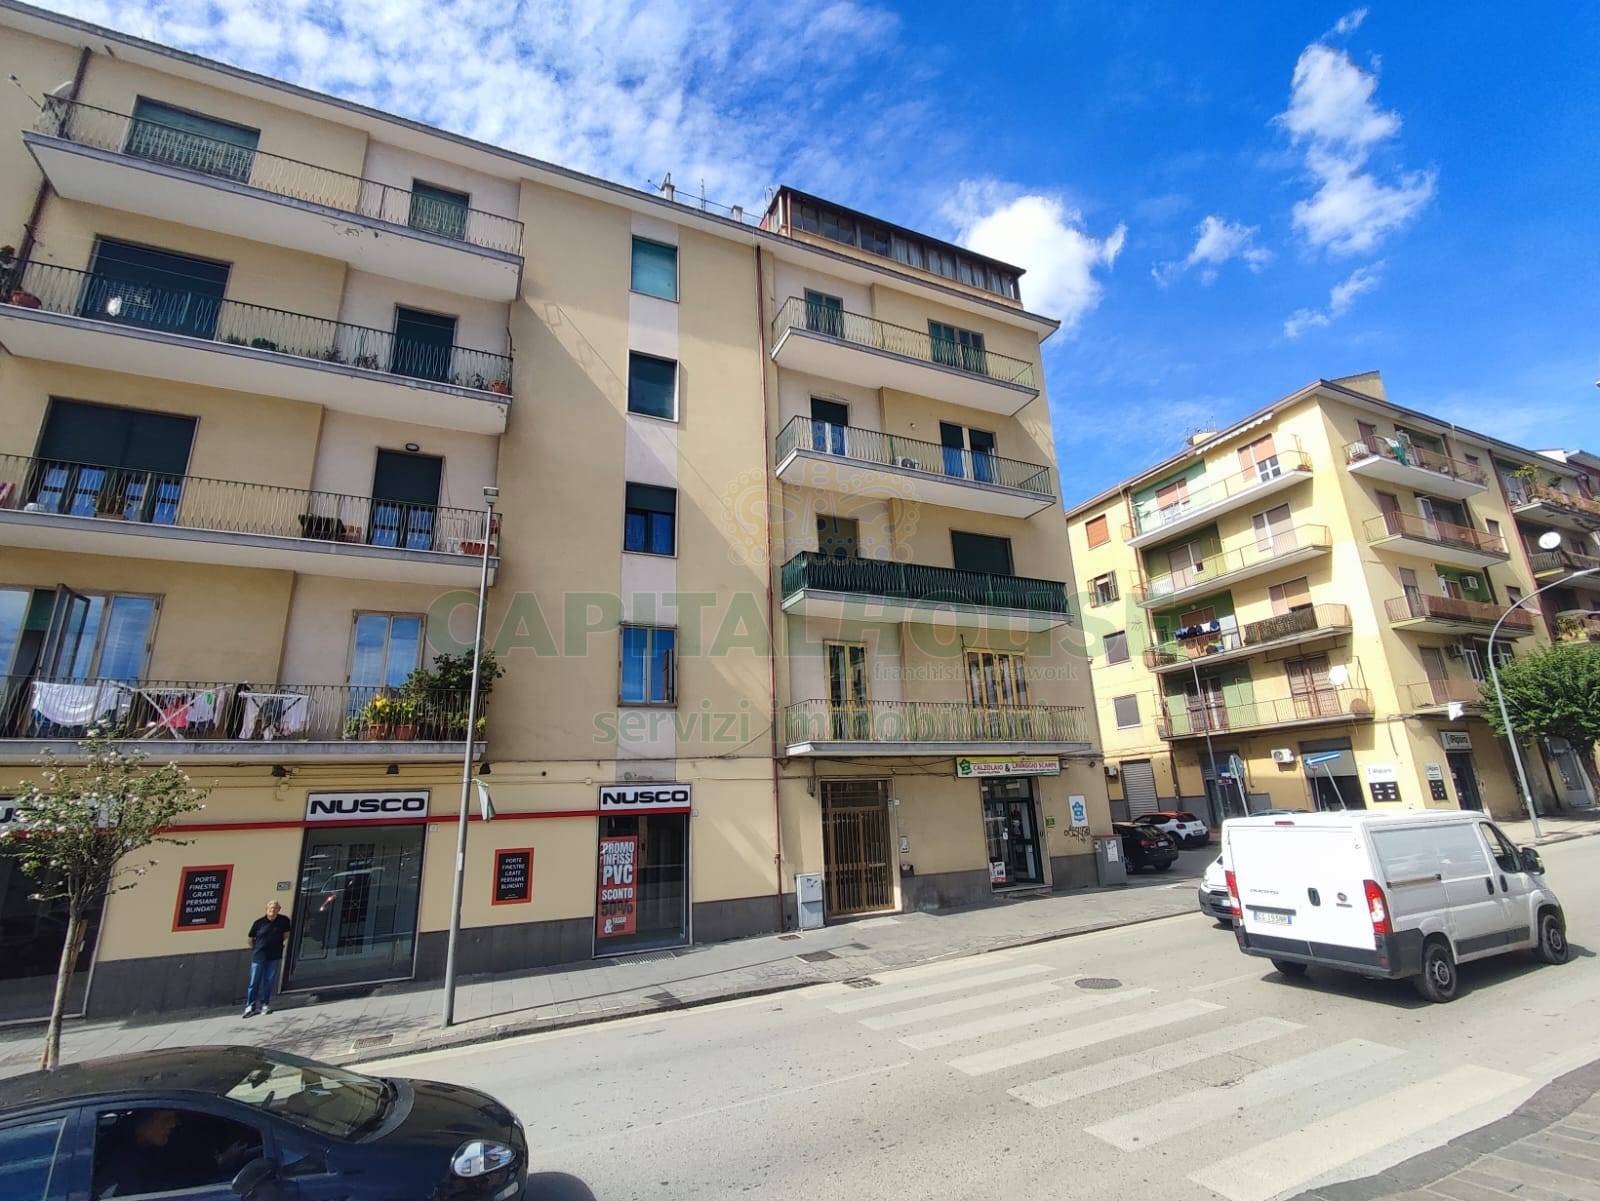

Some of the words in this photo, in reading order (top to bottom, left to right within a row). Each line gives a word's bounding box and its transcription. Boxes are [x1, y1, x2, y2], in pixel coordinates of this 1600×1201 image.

[1004, 763, 1011, 772] &
[602, 790, 688, 805] NUSCO
[310, 798, 425, 814] NUSCO
[602, 841, 635, 854] PROMO
[603, 852, 634, 865] INFISSI
[603, 864, 633, 886] PVC
[601, 887, 633, 900] SCONTO
[186, 898, 217, 906] PERSIANE
